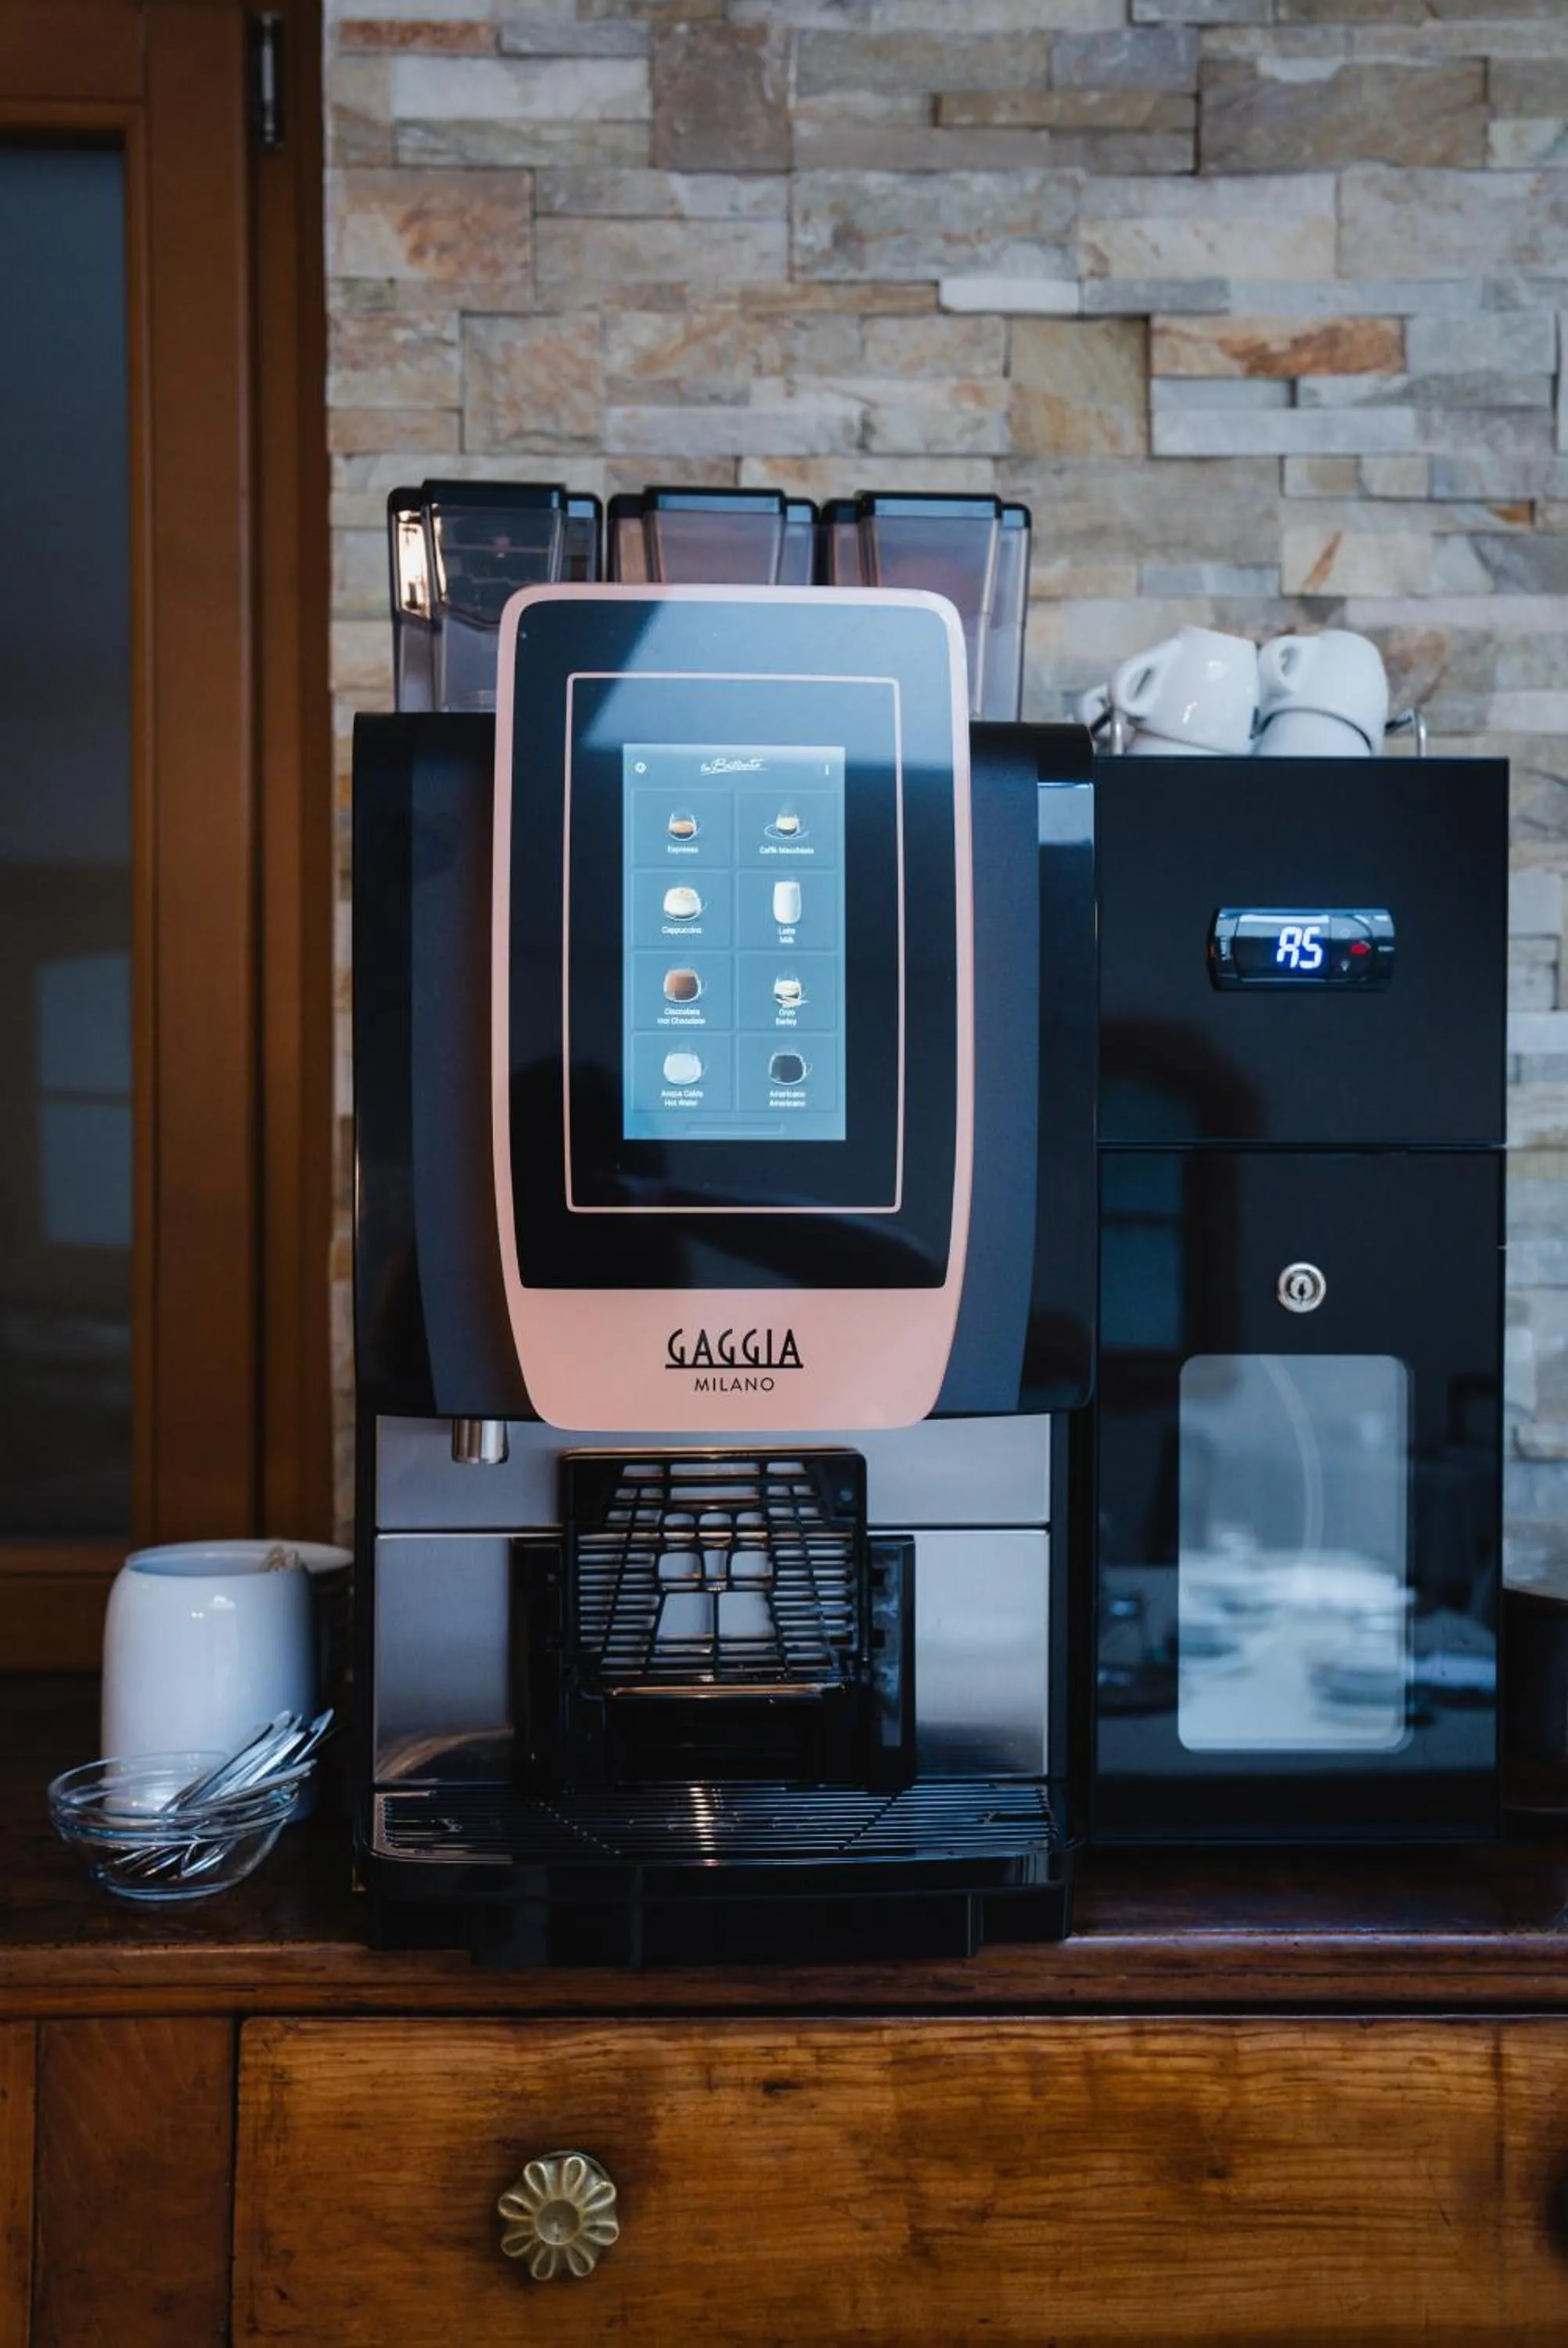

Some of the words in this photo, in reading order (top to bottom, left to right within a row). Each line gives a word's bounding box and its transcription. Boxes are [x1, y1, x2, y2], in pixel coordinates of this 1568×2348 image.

[667, 844, 699, 855] Espresso
[662, 926, 702, 935] Cappuccino
[671, 1017, 706, 1025] Chocolate
[775, 1017, 797, 1027] Barley
[664, 1098, 678, 1107] Hot
[667, 1328, 801, 1367] GAGGIA
[694, 1377, 775, 1392] MILANO
